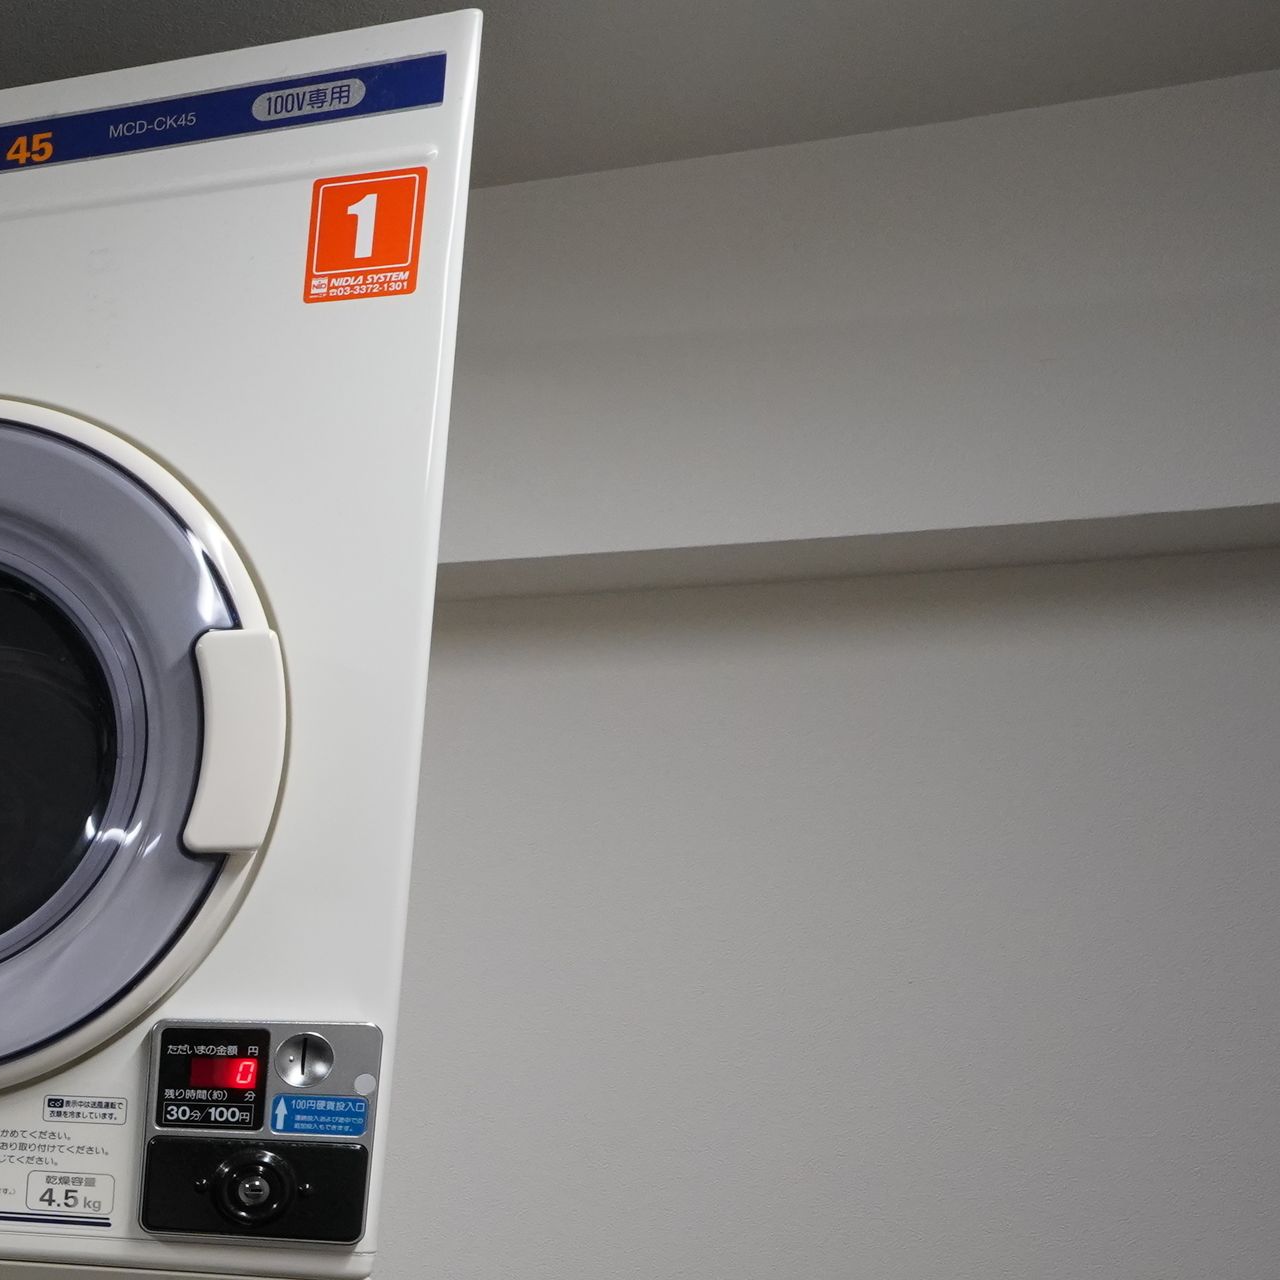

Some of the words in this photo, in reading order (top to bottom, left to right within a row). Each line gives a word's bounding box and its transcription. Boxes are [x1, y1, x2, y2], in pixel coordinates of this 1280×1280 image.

[266, 85, 350, 116] 100V専用
[108, 112, 197, 140] MCD-CK45
[5, 132, 53, 164] 45
[347, 193, 378, 259] 1
[329, 275, 363, 287] NIDLA
[365, 271, 409, 284] SYSTEM
[167, 1045, 238, 1056] ただいまの金額
[248, 1046, 259, 1056] 円
[236, 1062, 254, 1083] 0
[244, 1091, 256, 1101] 分
[45, 1175, 96, 1187] 乾燥容量
